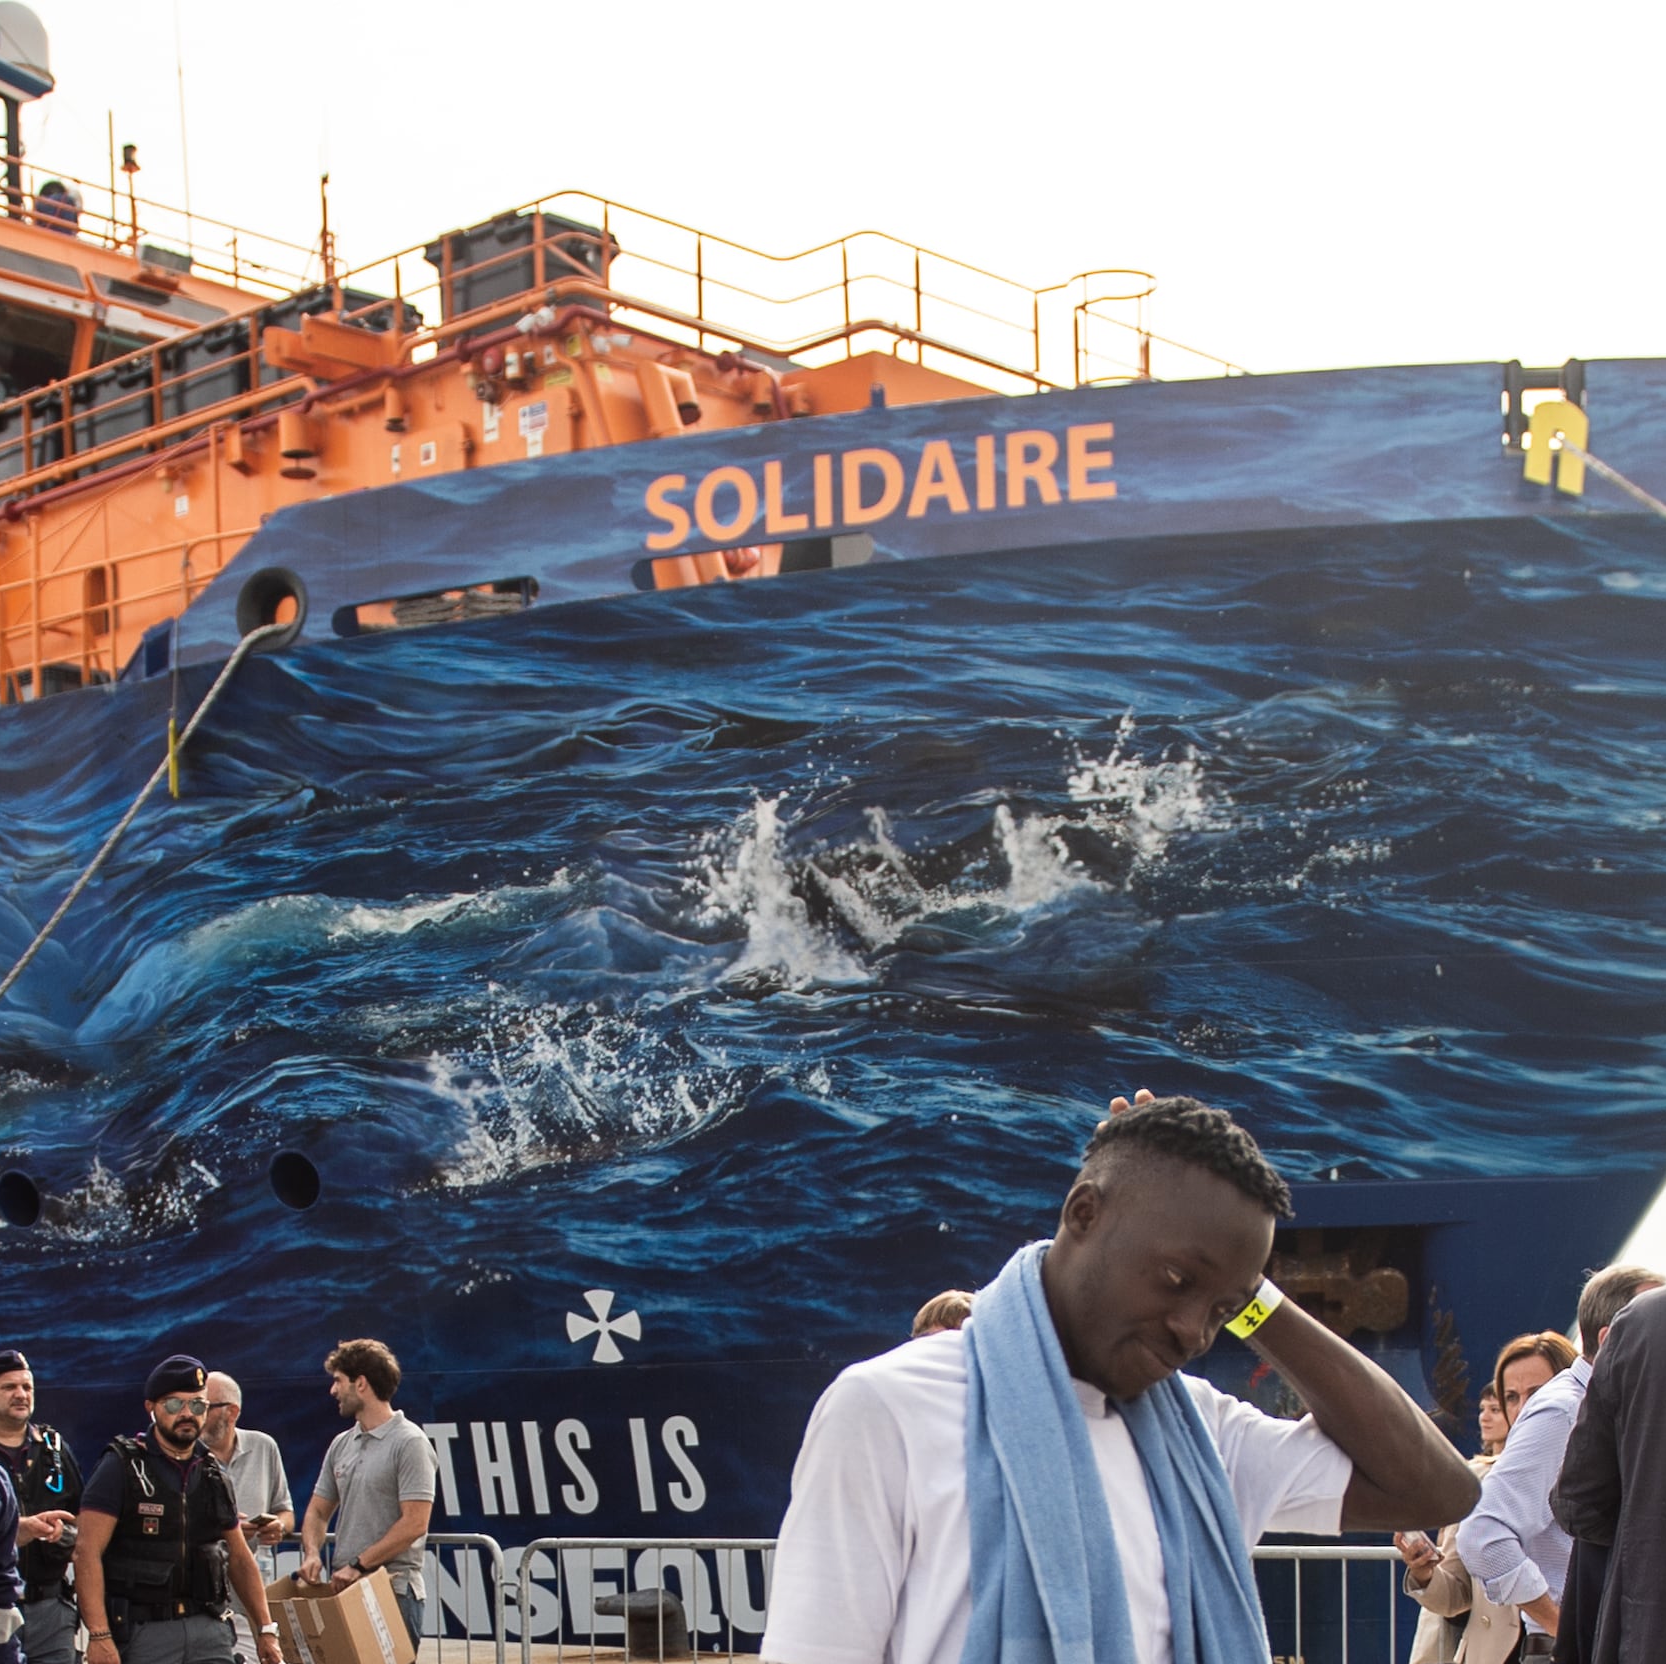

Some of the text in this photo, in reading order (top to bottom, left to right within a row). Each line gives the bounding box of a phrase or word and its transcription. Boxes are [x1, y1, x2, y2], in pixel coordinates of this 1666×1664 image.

[645, 422, 1118, 551] SOLIDAIRE
[422, 1415, 708, 1517] THIS IS
